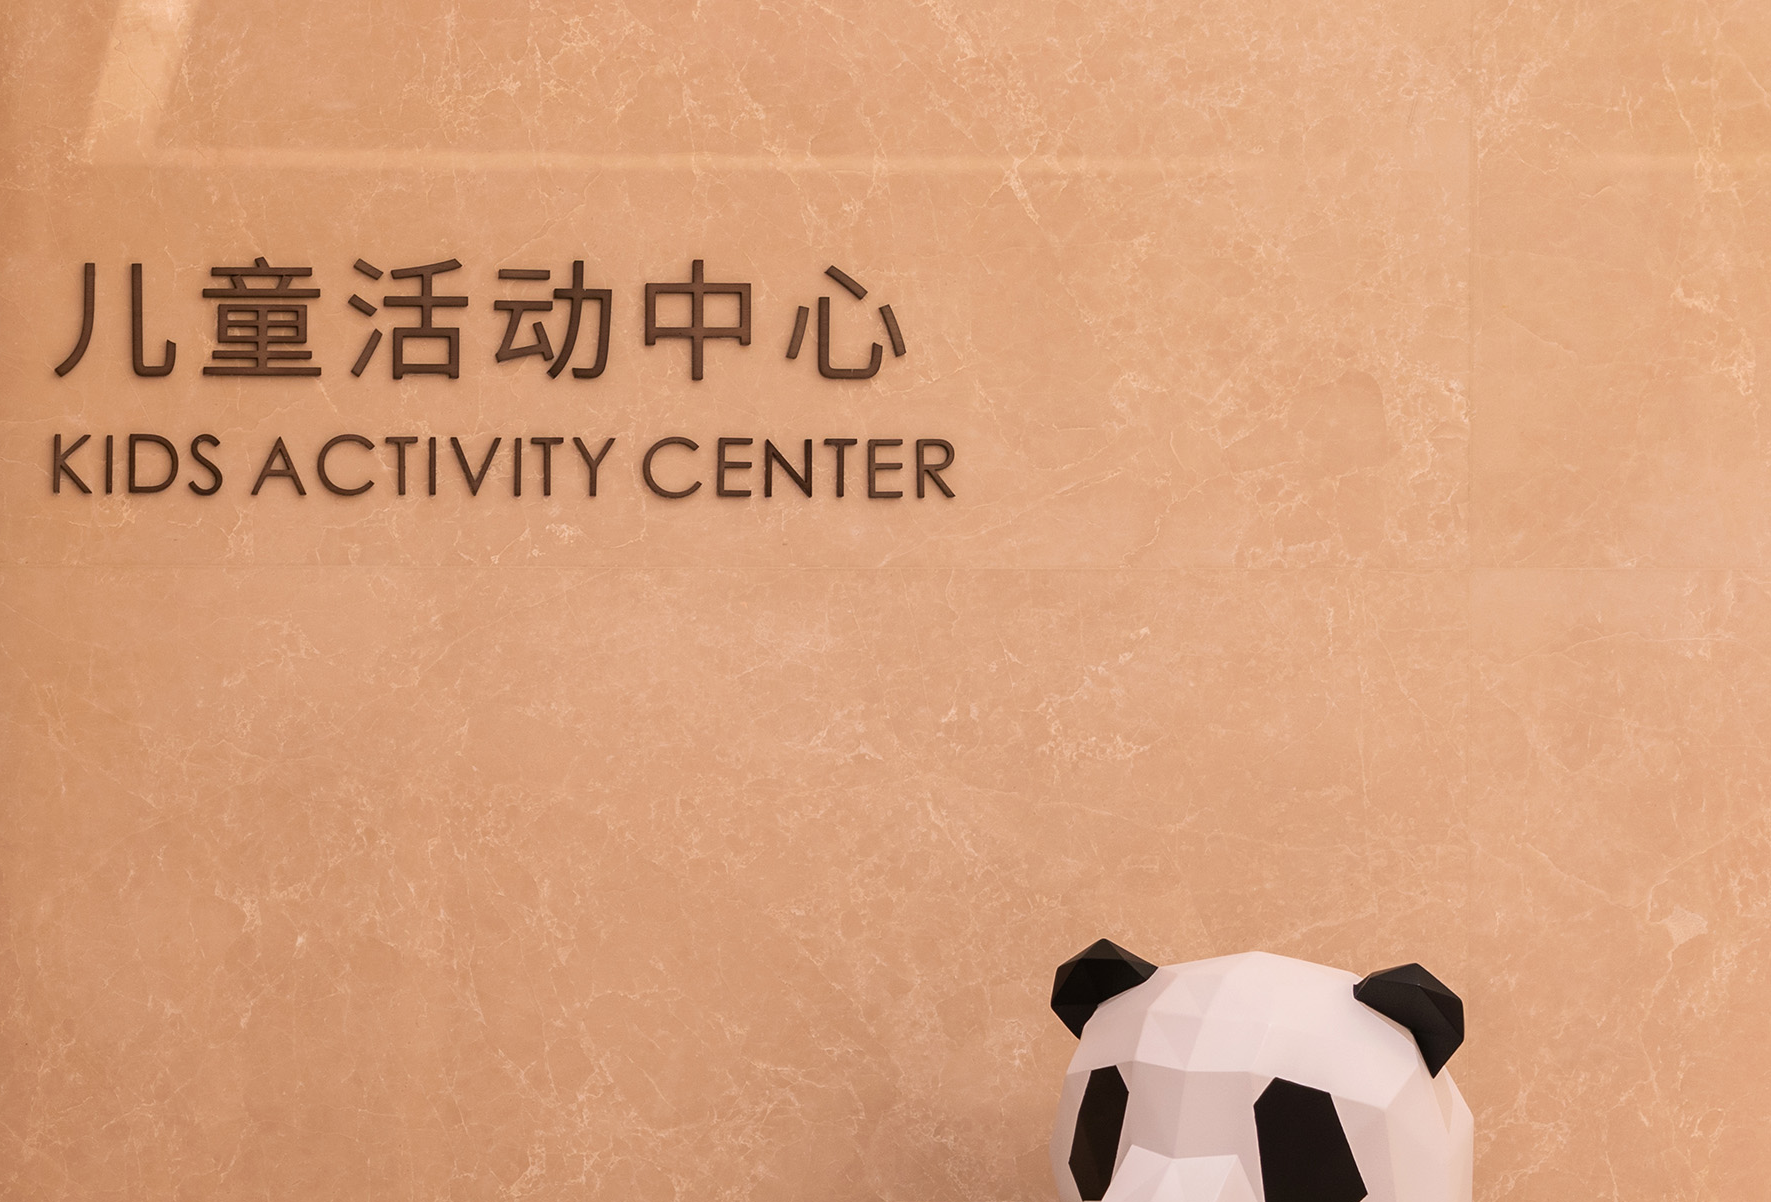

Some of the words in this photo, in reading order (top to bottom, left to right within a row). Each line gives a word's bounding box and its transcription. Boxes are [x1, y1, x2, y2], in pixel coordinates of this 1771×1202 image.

[52, 256, 909, 382] 儿童活动中心
[52, 433, 224, 498] KIDS
[250, 433, 616, 499] ACTIVITY
[642, 435, 957, 500] CENTER
